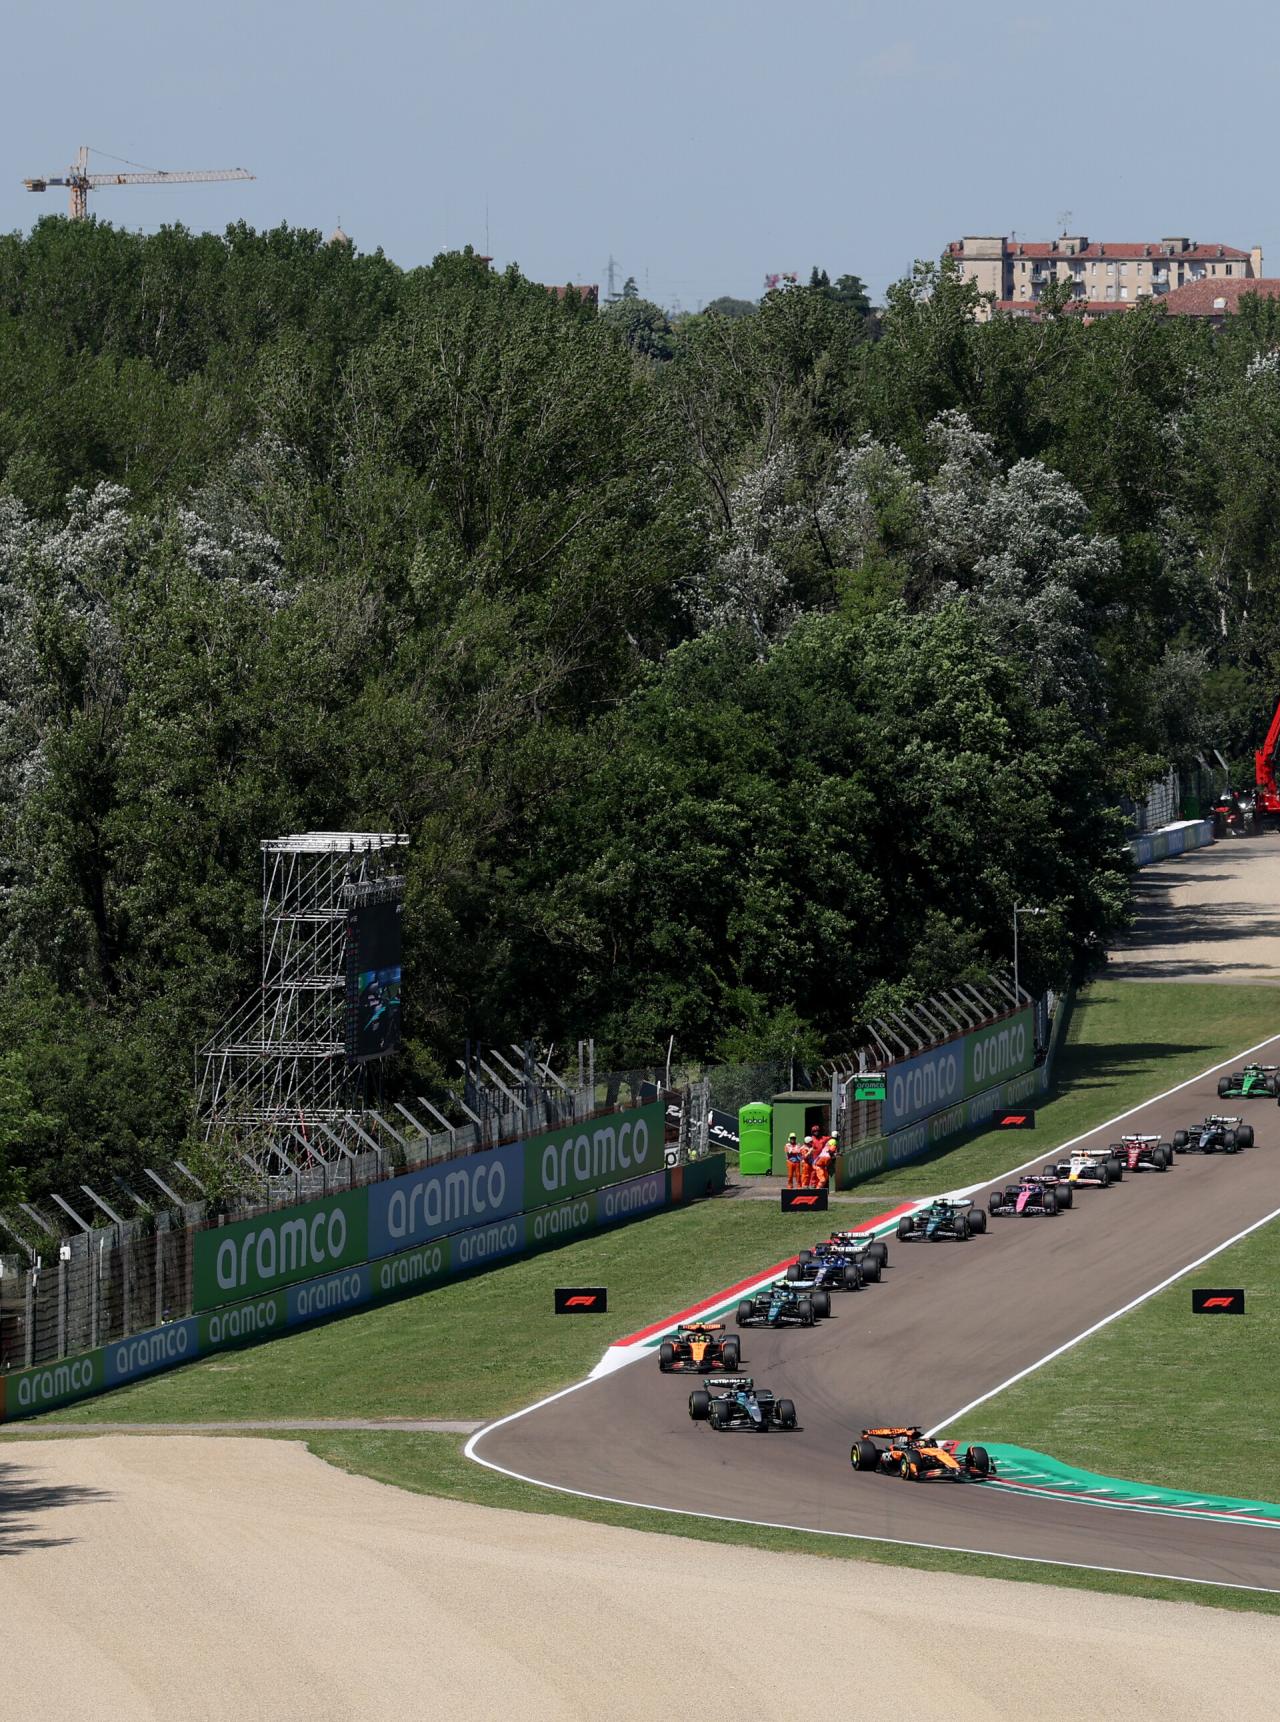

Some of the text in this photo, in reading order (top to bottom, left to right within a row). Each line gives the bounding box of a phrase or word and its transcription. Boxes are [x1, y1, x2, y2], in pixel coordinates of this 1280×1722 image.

[973, 1024, 1025, 1083] aramco
[893, 1055, 957, 1117] aramco
[541, 1119, 649, 1191] aramco
[849, 1144, 883, 1177] aramco
[388, 1161, 505, 1238] aramco
[534, 1201, 589, 1240] aramco
[605, 1180, 657, 1217] aramco
[216, 1207, 347, 1290] aramco
[459, 1224, 518, 1263] aramco
[380, 1247, 442, 1289] aramco
[297, 1272, 361, 1315] aramco
[208, 1299, 277, 1343] aramco
[116, 1326, 188, 1374] aramco
[18, 1358, 93, 1406] aramco
